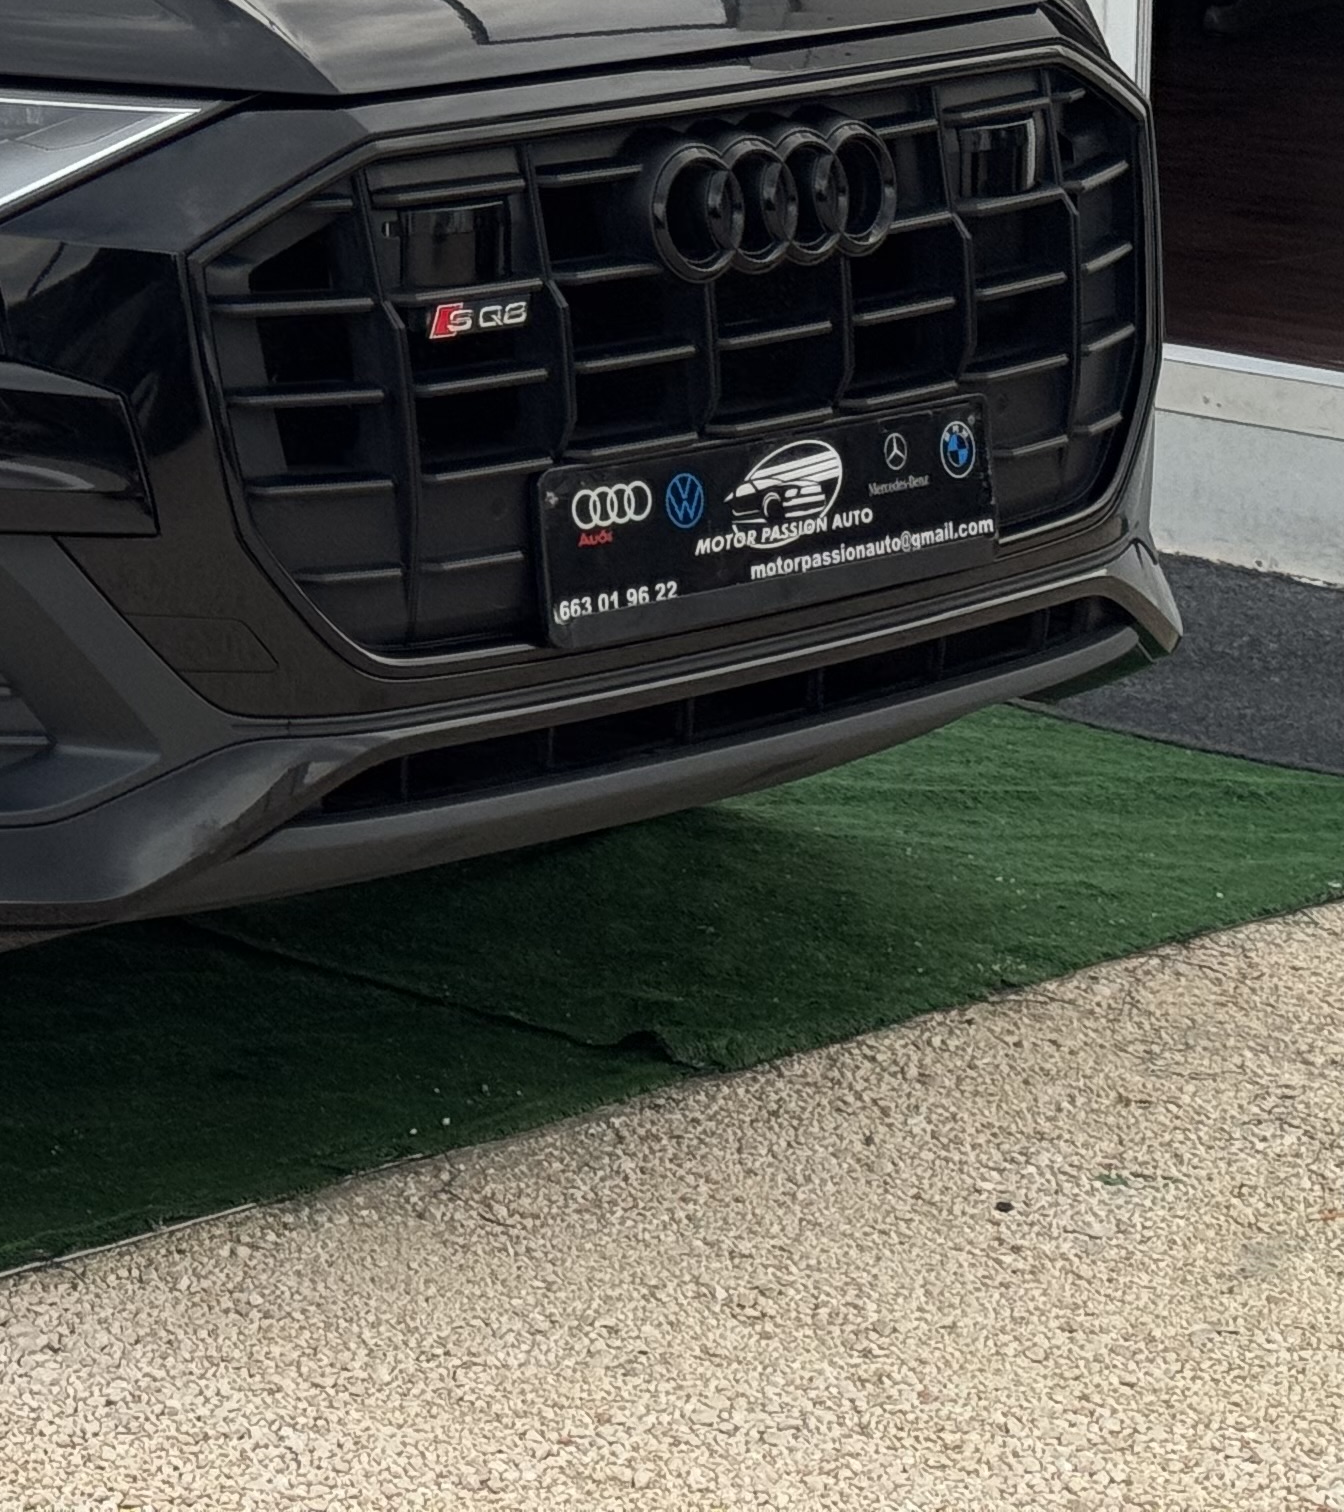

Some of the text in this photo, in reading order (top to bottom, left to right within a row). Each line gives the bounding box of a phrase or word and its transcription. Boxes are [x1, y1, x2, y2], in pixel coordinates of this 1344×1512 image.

[577, 530, 615, 548] Audi
[694, 507, 874, 557] MOTOR PASSION AUTO
[750, 517, 995, 581] motorpassionauto@gmail.com
[597, 590, 620, 614] 01
[625, 585, 651, 607] 96
[654, 580, 679, 602] 22
